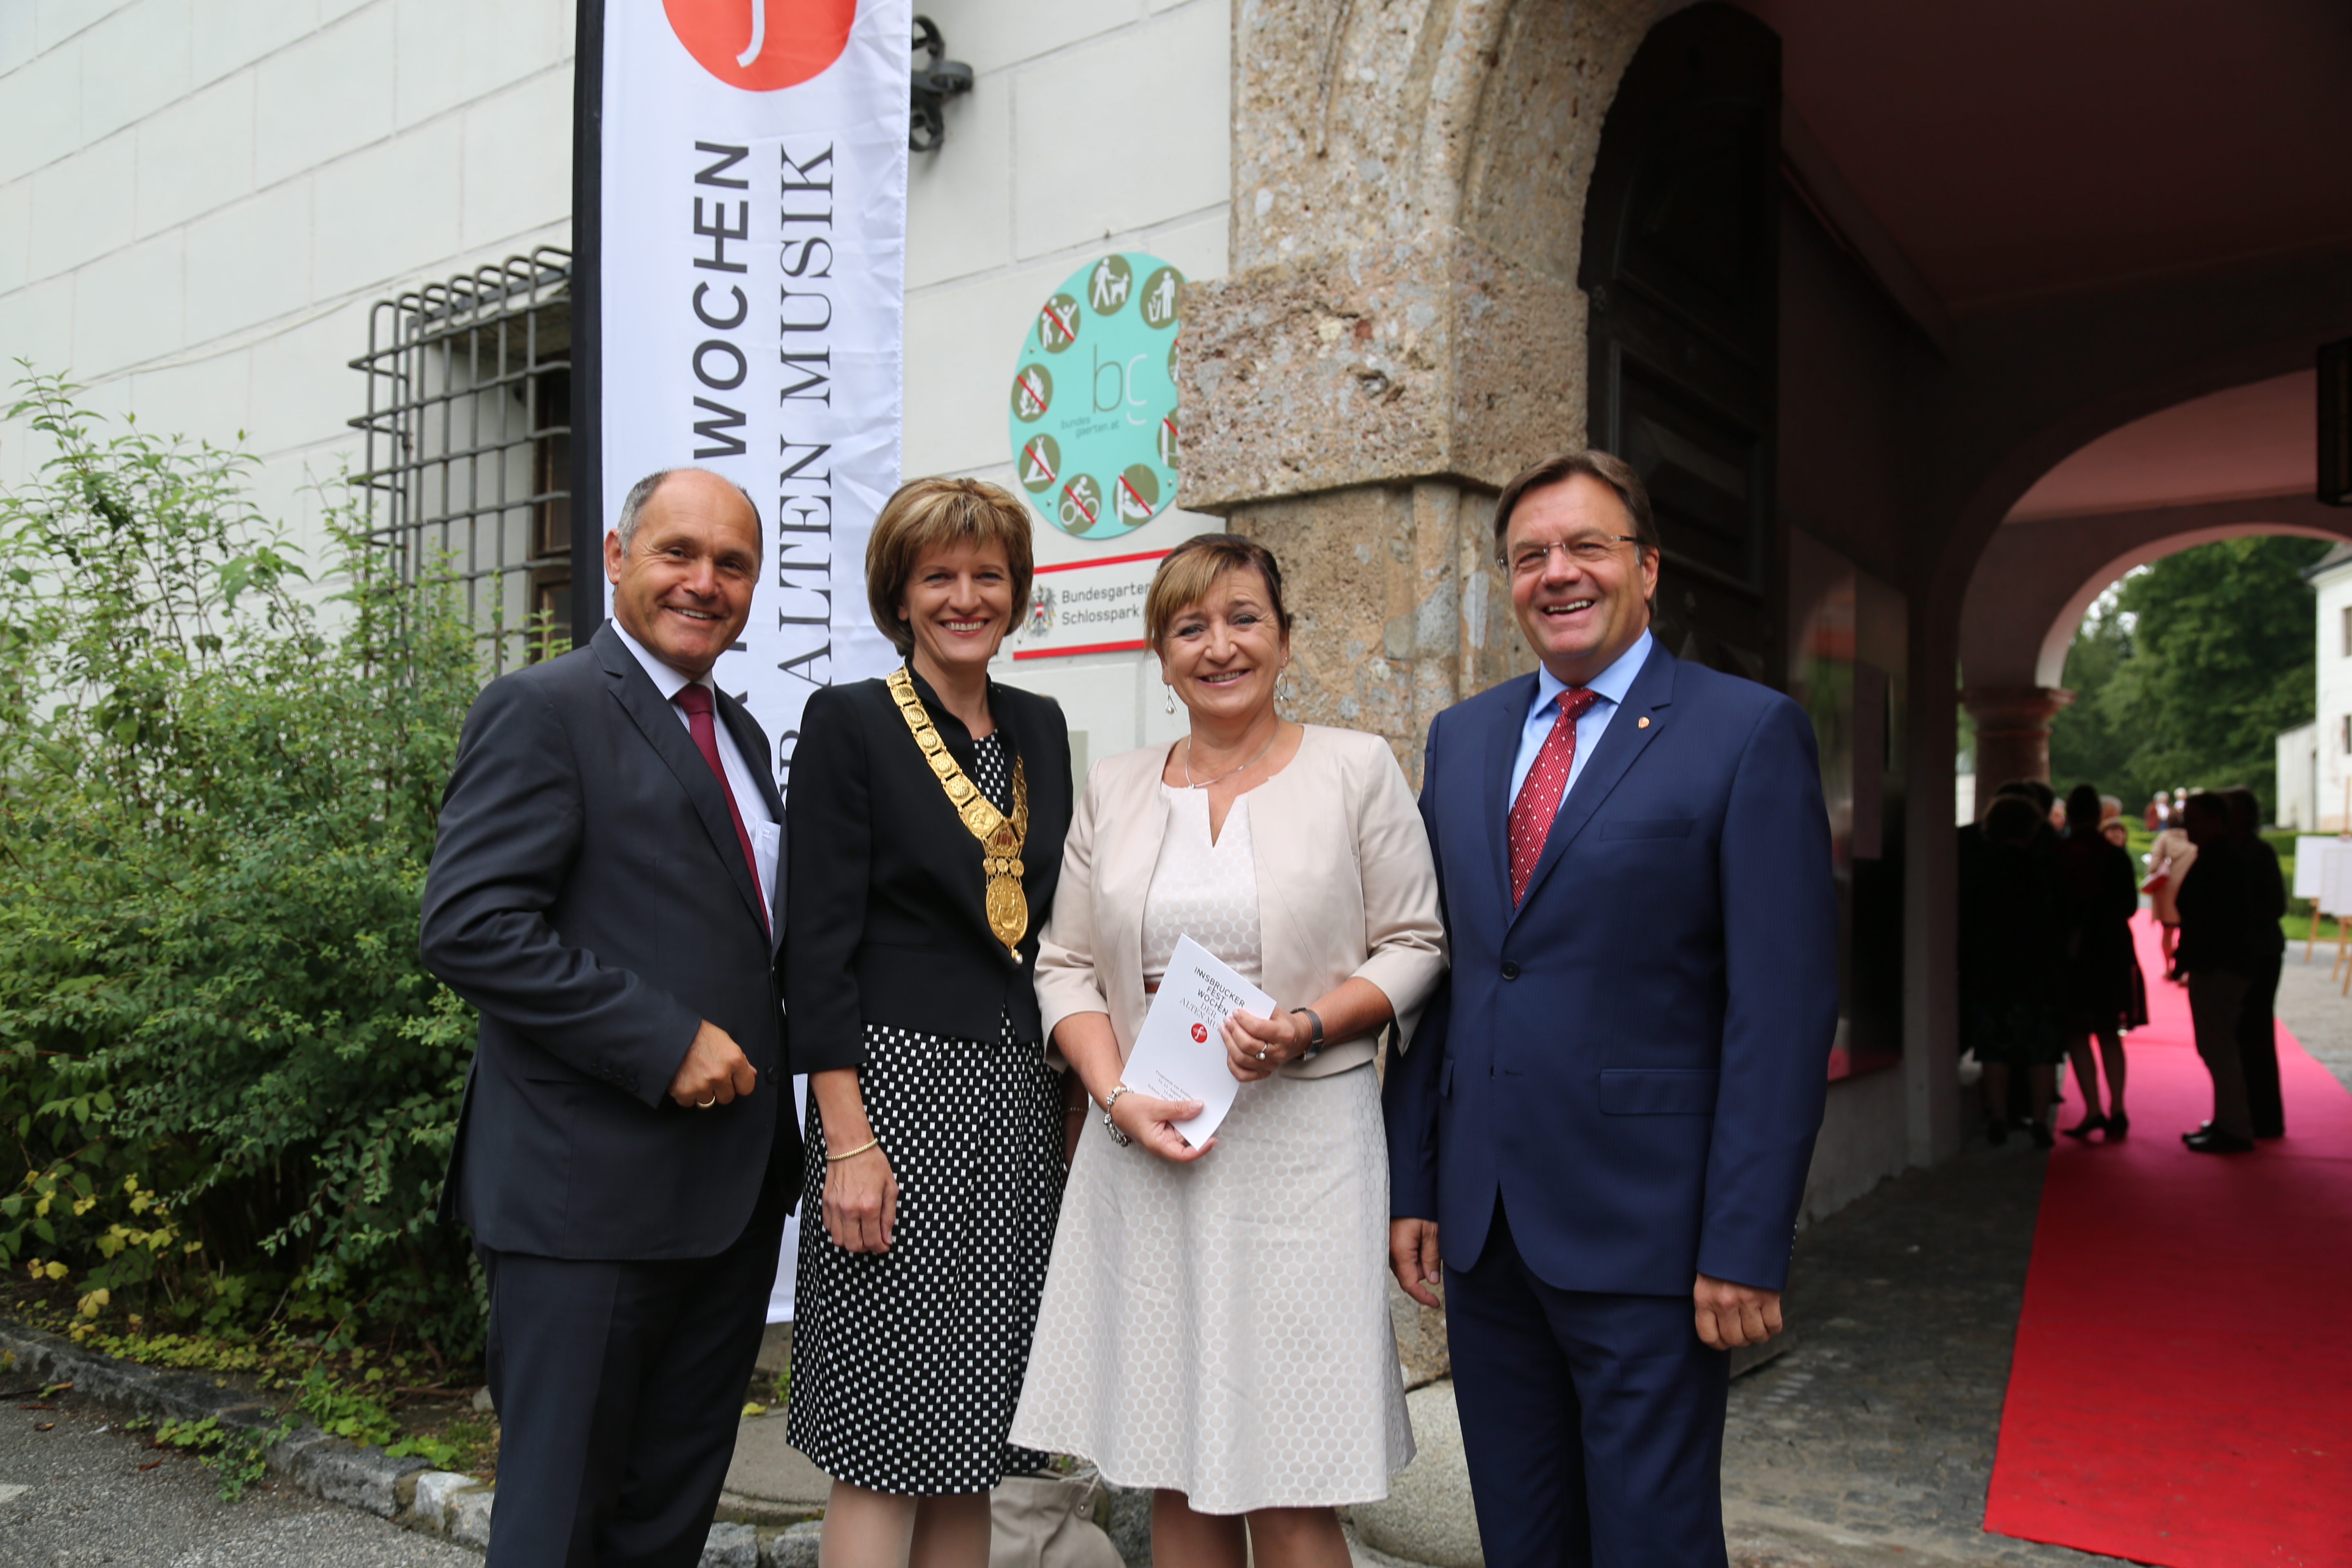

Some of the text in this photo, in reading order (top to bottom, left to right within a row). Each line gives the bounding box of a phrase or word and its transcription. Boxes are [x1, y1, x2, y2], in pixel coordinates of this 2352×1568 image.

[692, 140, 749, 459] WOCHEN
[777, 140, 833, 687] ALTEN MUSIK
[1060, 416, 1091, 429] bundes
[1076, 420, 1119, 439] gaerten.at
[1062, 604, 1140, 625] Schlosspark
[1194, 966, 1245, 1008] INNSBRUCKER
[1206, 985, 1225, 1002] FEST
[1180, 997, 1218, 1031] ALTEN MU
[1197, 988, 1229, 1017] WOCHEN
[1200, 1002, 1217, 1019] DER
